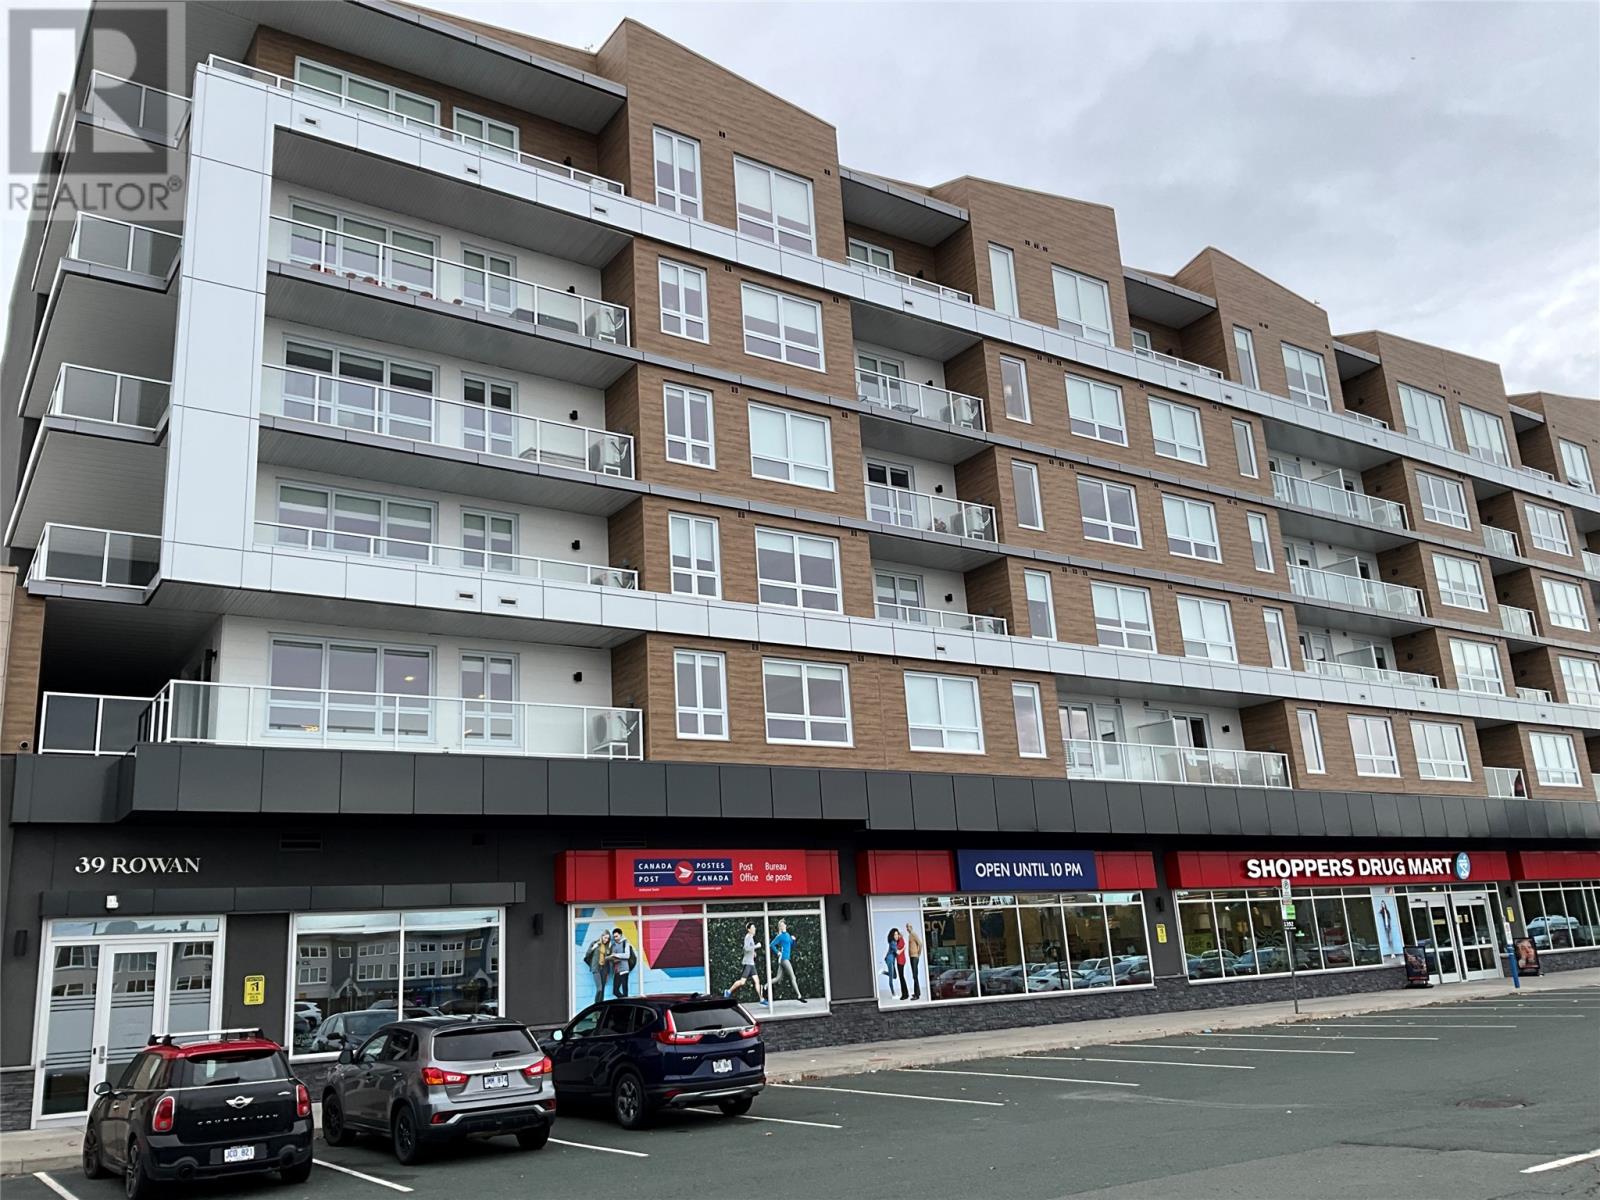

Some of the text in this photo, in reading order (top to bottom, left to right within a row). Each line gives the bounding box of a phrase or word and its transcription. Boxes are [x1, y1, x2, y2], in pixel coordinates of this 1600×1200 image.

[75, 856, 200, 874] 39 ROWAN
[739, 862, 753, 871] Post
[765, 862, 787, 871] Bureau
[975, 862, 1083, 878] OPEN UNTIL 10 PM
[1247, 858, 1452, 878] SHOPPERS DRUG MART
[740, 873, 759, 882] Office
[765, 873, 792, 883] de poste
